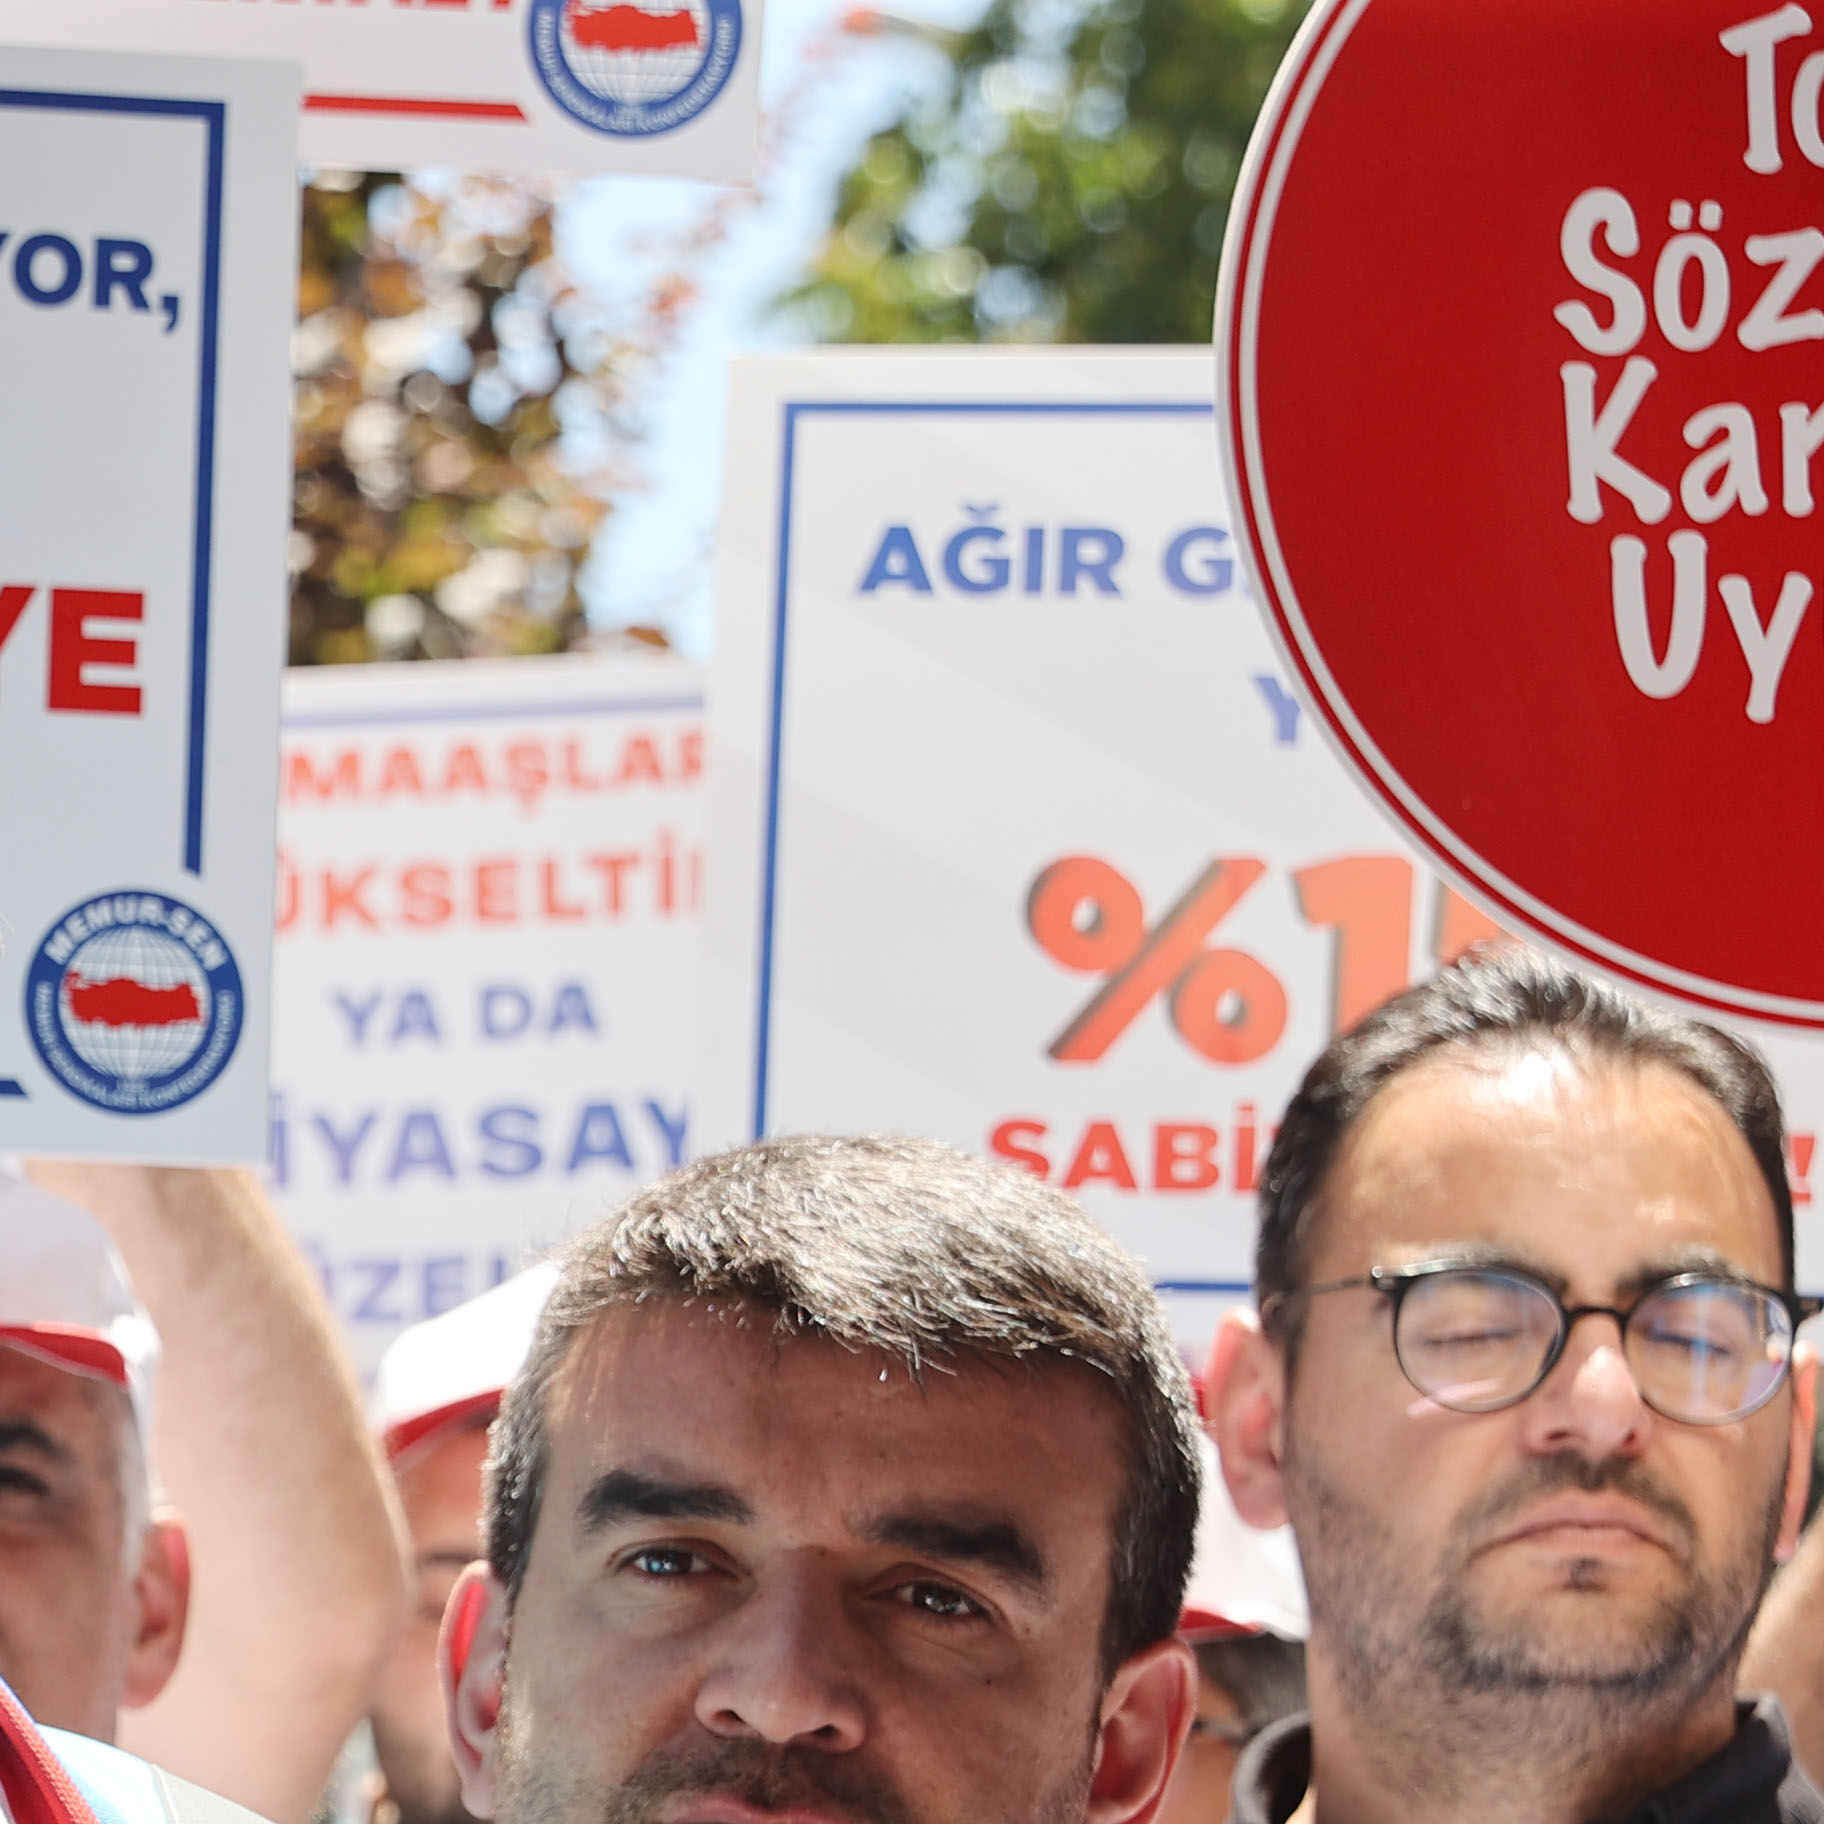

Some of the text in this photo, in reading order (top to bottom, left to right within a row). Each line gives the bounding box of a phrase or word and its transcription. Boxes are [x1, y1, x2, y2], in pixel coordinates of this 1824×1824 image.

[858, 498, 1127, 599] AĞIR
[44, 893, 230, 971] MEMUR-SEN
[276, 828, 704, 938] KSELTİ
[332, 978, 600, 1047] YA DA
[987, 1101, 1278, 1199] SABİ
